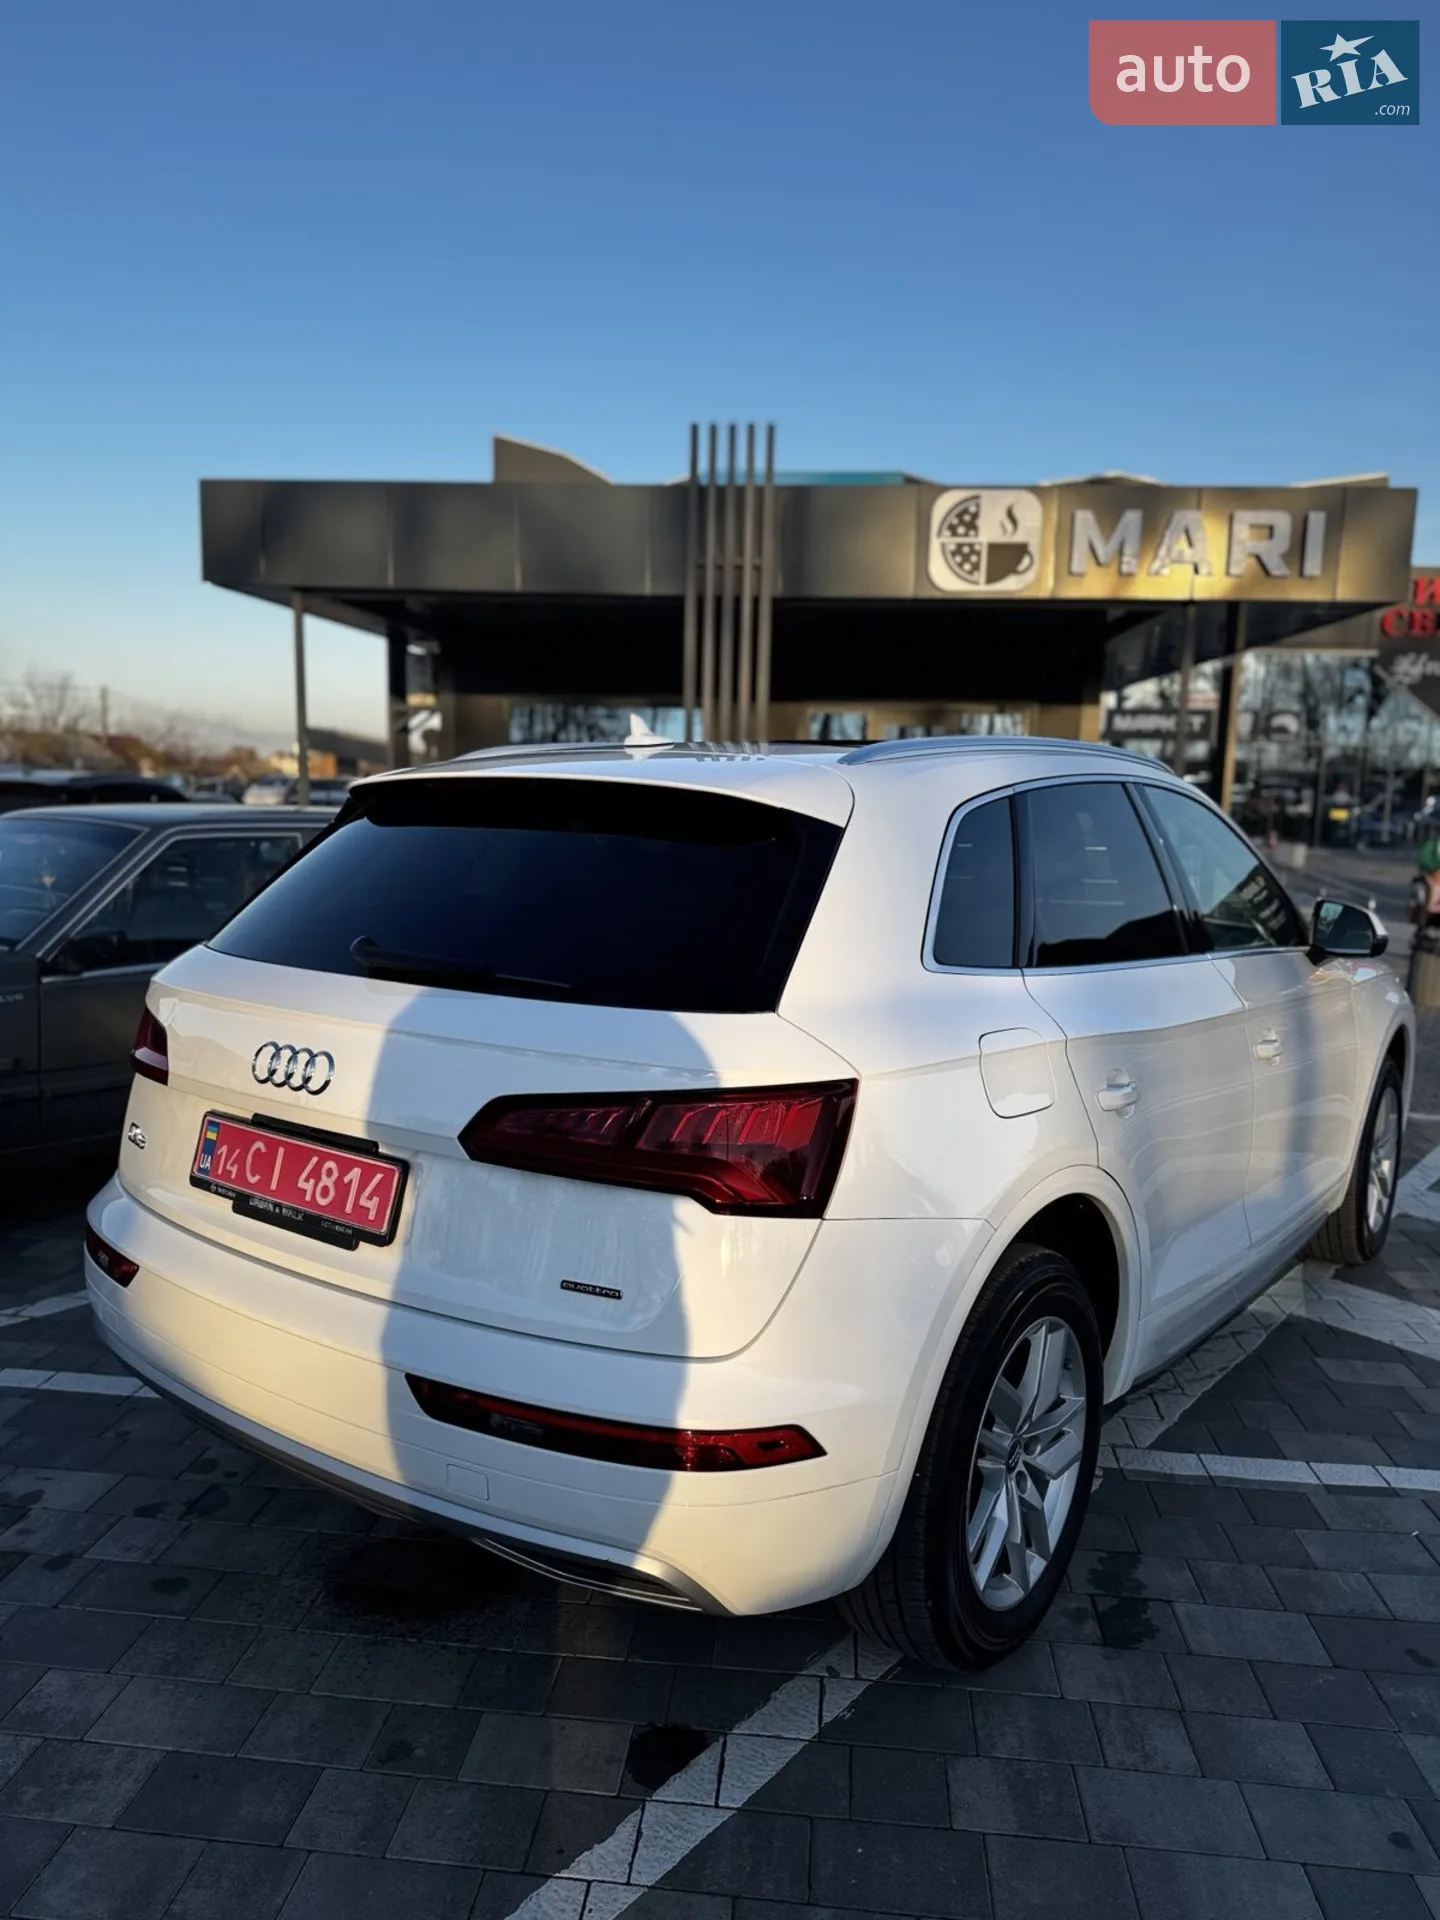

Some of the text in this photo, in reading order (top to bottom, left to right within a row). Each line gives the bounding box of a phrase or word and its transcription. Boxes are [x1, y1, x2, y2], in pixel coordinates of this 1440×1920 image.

[1069, 508, 1327, 577] MARI
[200, 1153, 211, 1171] UA
[297, 1155, 385, 1221] 4814
[562, 1281, 619, 1297] quattro
